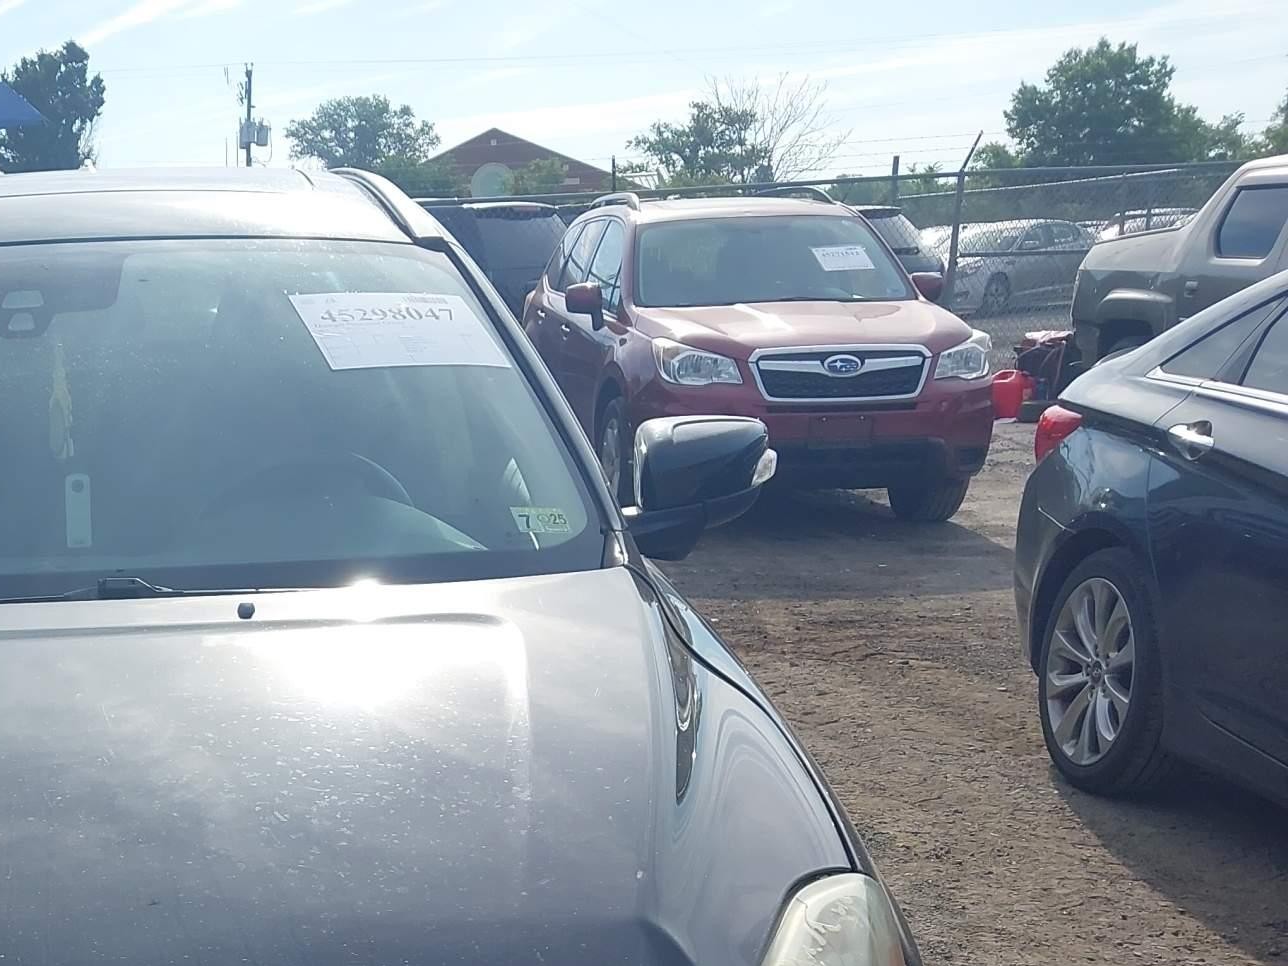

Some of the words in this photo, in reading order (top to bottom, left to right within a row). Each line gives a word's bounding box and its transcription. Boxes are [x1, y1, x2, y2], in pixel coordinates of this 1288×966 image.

[320, 307, 454, 322] 45298047
[518, 513, 531, 529] 7
[548, 513, 568, 525] 25
